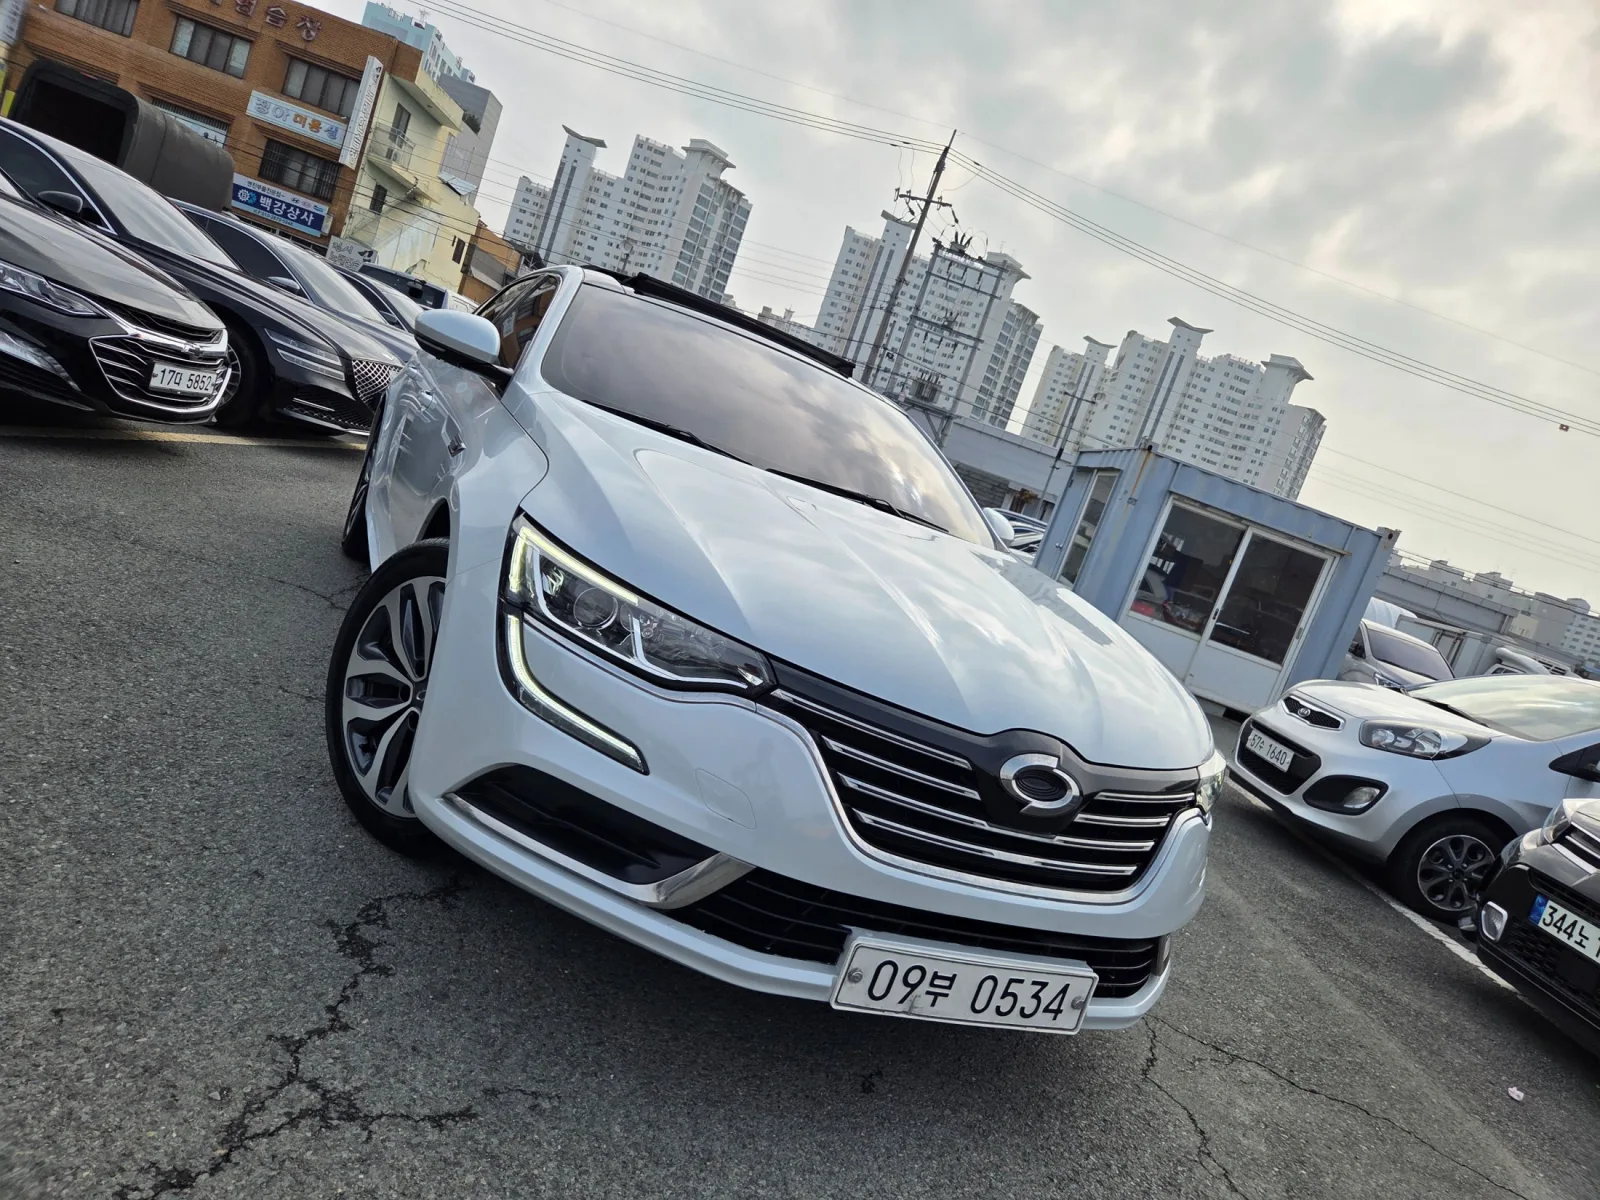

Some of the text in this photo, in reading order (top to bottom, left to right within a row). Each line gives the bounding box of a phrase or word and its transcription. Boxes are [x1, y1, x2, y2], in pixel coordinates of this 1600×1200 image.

[259, 195, 314, 226] 백강상사
[160, 368, 212, 392] 17다 5852
[1250, 734, 1288, 766] 57수 1640
[1542, 905, 1590, 949] 344노
[867, 959, 1071, 1021] 09부 0534
